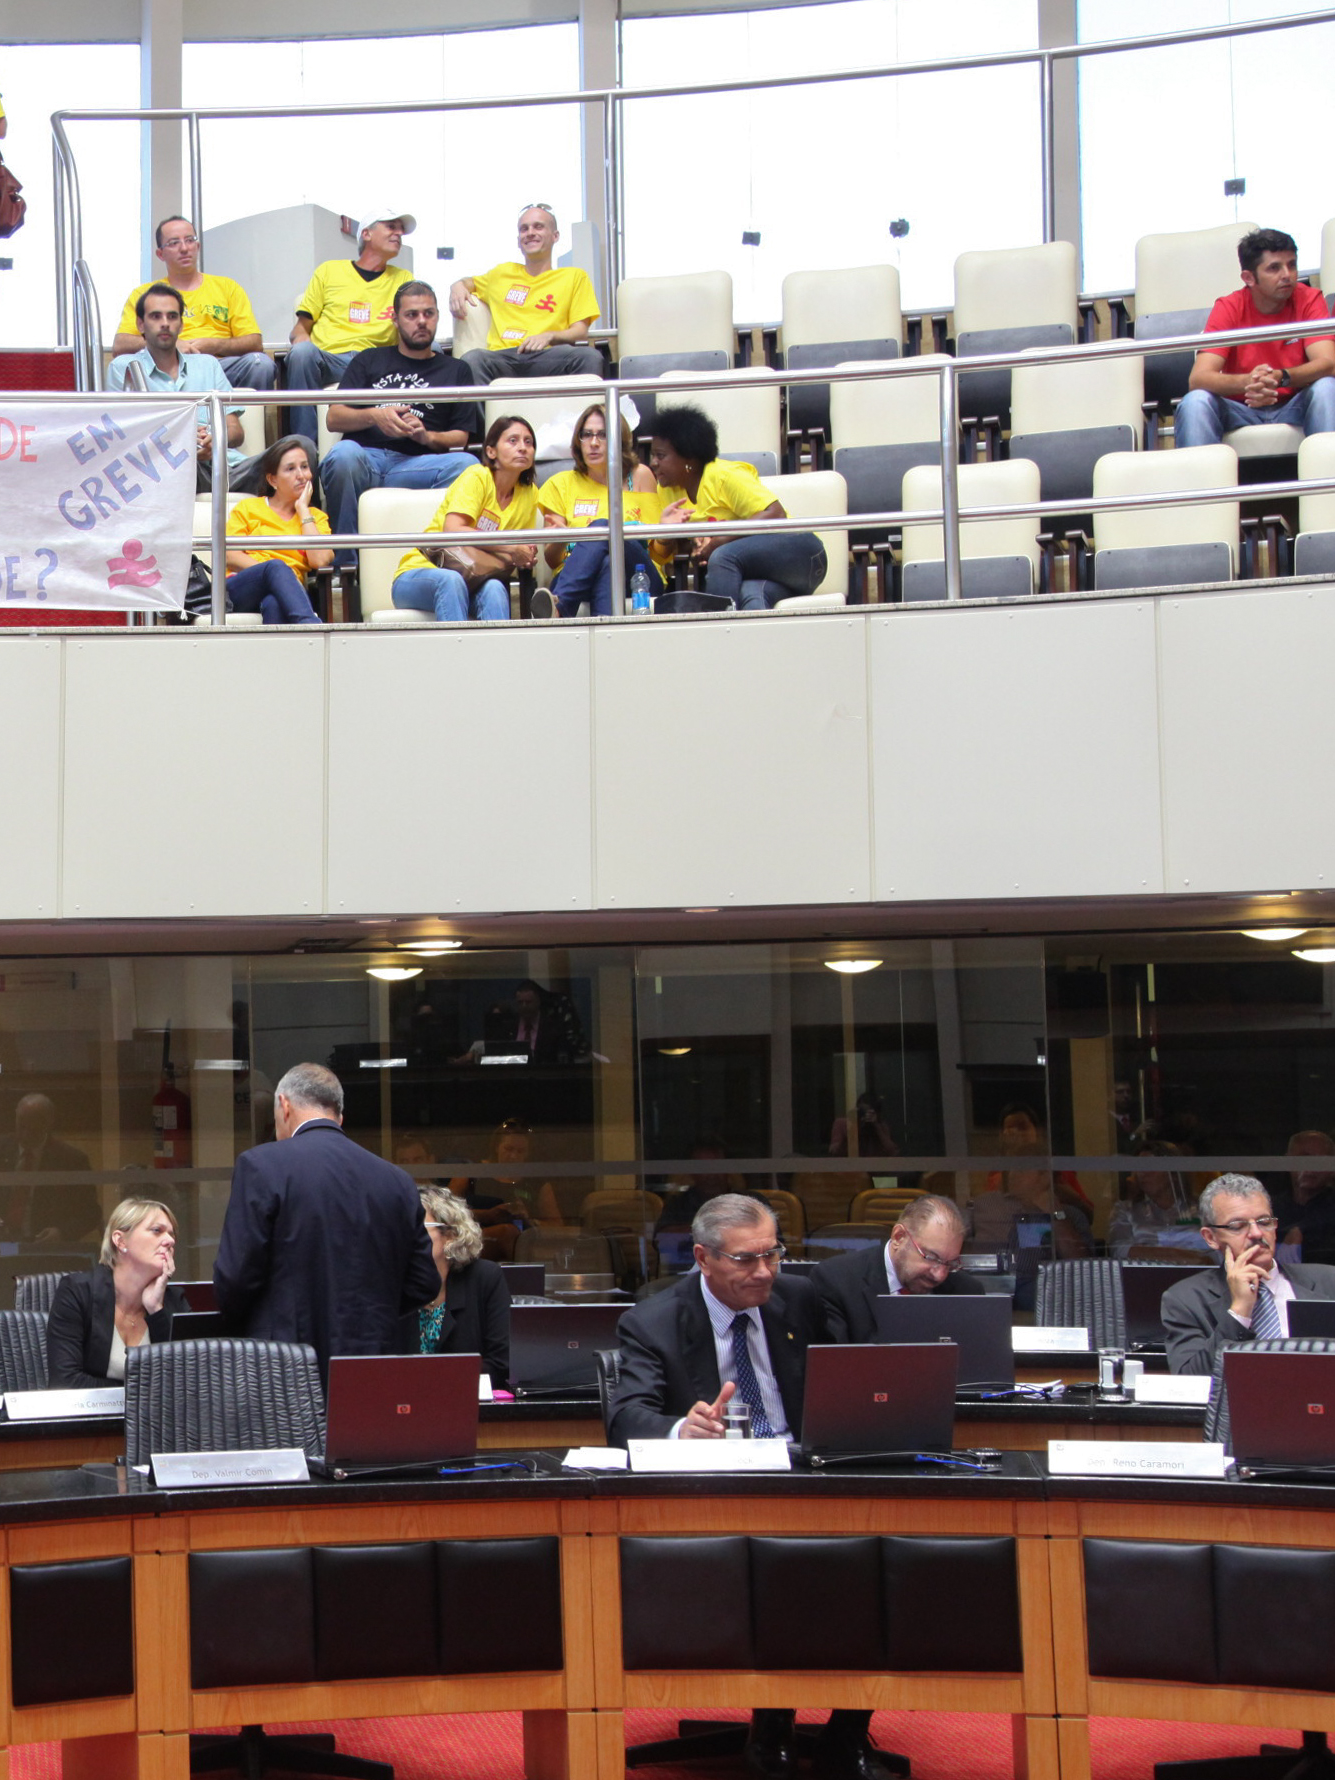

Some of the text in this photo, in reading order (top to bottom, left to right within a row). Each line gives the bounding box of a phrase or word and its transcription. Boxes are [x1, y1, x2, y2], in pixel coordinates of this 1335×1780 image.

[66, 413, 127, 465] EM
[58, 425, 190, 530] GREVE
[192, 1470, 213, 1480] Dep.
[245, 1467, 273, 1477] Comin
